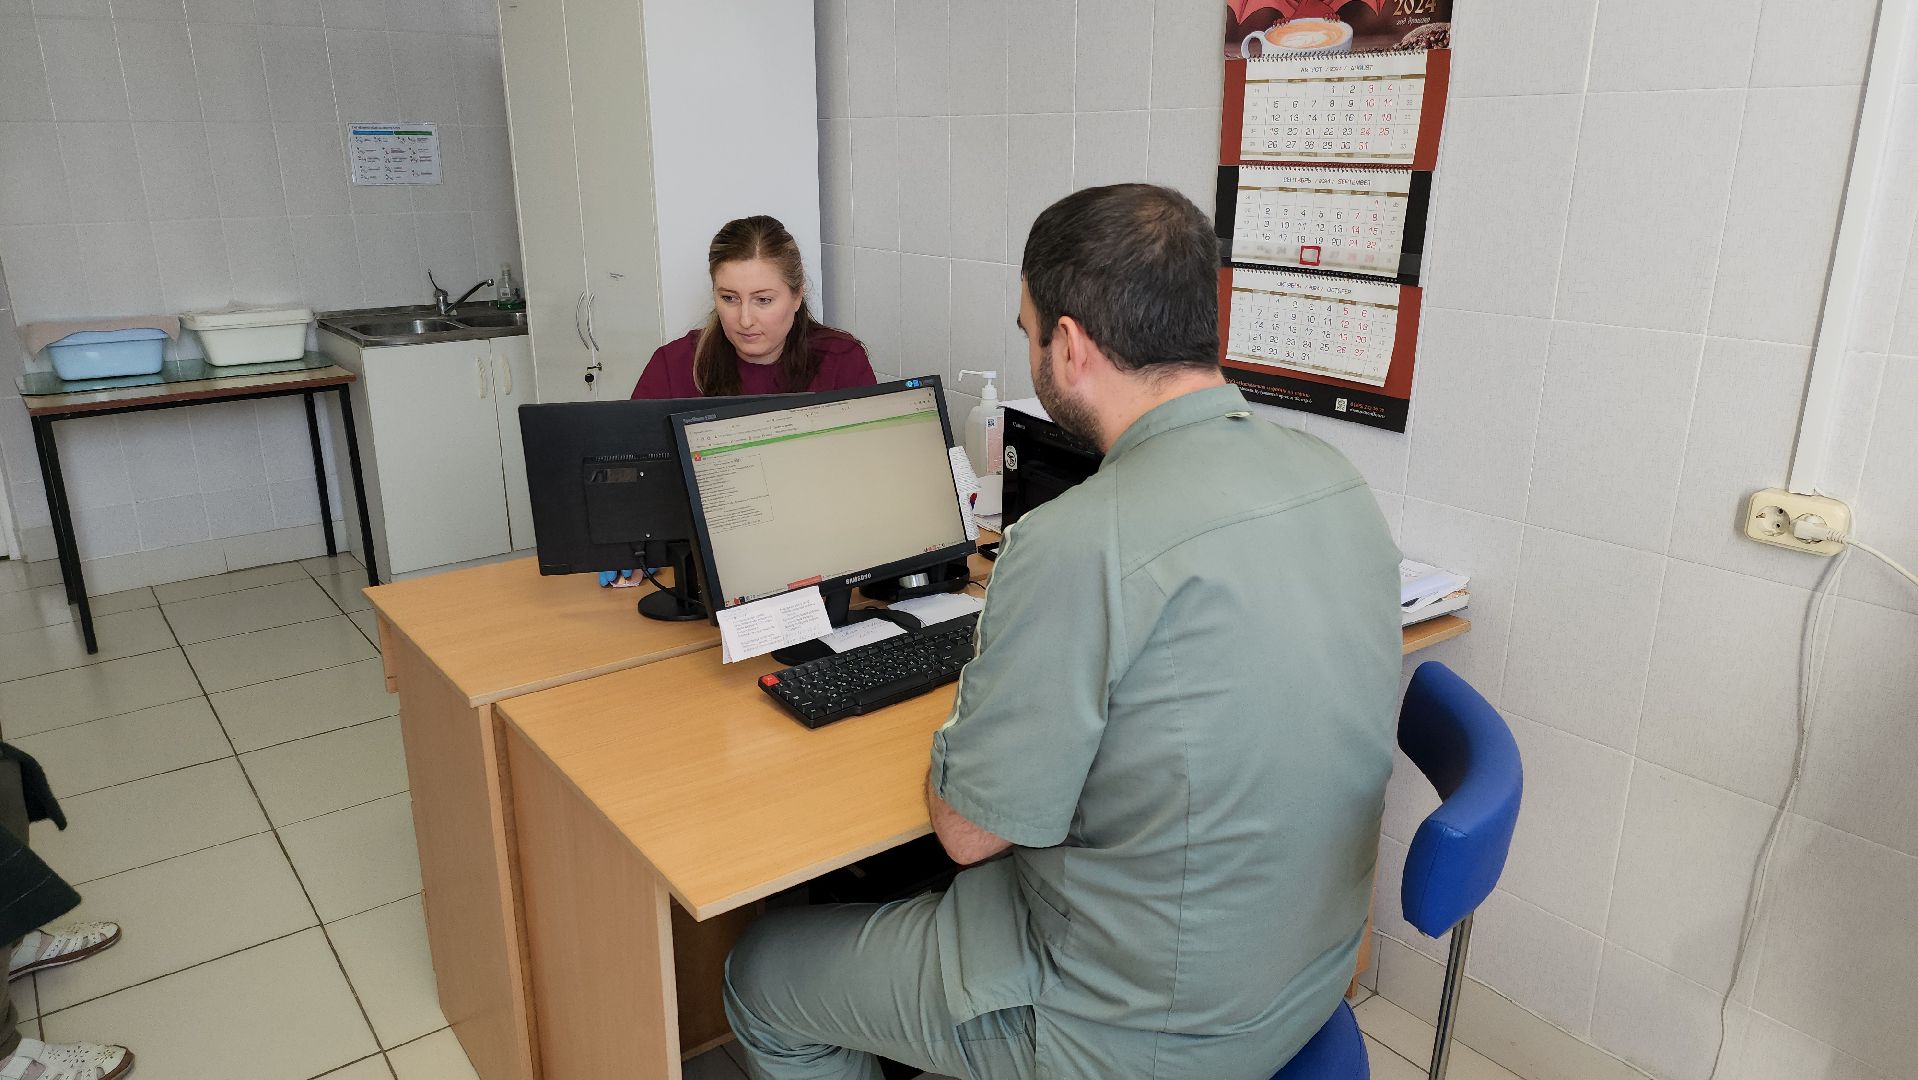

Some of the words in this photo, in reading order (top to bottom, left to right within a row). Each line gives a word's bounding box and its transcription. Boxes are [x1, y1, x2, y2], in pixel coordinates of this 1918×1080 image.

[1393, 0, 1437, 16] 2024
[1349, 85, 1356, 93] 2
[1311, 100, 1317, 108] 7
[1272, 114, 1280, 122] 12
[1290, 114, 1299, 122] 13
[1308, 114, 1317, 122] 14
[1327, 114, 1336, 122] 15
[1345, 114, 1354, 122] 16
[1363, 114, 1373, 122] 17
[1342, 128, 1353, 136] 23
[1360, 128, 1371, 136] 24
[1378, 128, 1390, 136] 25
[1267, 140, 1278, 148] 26
[1285, 140, 1296, 148] 27
[1322, 141, 1333, 149] 29
[1336, 211, 1342, 219] 6
[1355, 211, 1360, 219] 7
[1333, 224, 1343, 233] 13
[1351, 225, 1360, 234] 14
[1369, 227, 1378, 235] 15
[1297, 235, 1306, 244] 18
[1314, 236, 1324, 244] 19
[1326, 304, 1332, 312] 4
[1343, 306, 1349, 315] 5
[1307, 315, 1316, 323] 10
[1323, 317, 1332, 326] 11
[1340, 319, 1350, 328] 12
[1302, 340, 1312, 348] 24
[1320, 342, 1330, 351] 25
[1301, 352, 1310, 361] 31
